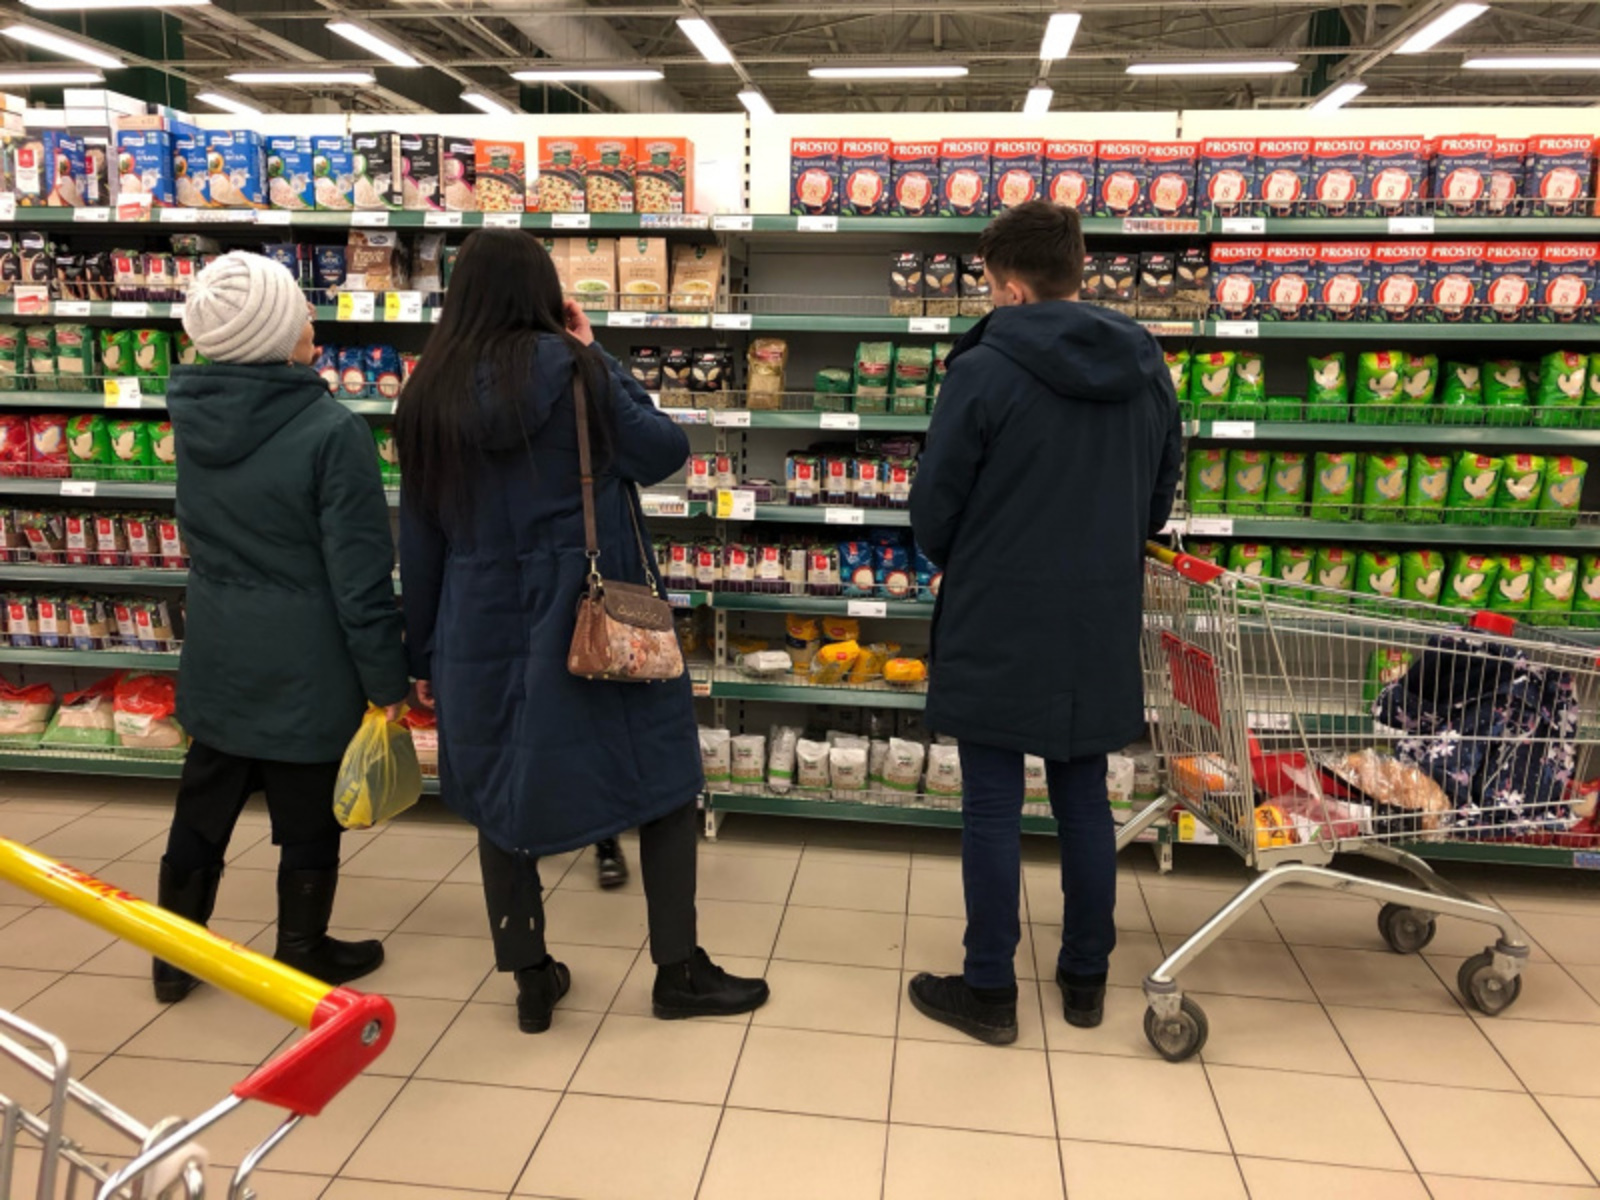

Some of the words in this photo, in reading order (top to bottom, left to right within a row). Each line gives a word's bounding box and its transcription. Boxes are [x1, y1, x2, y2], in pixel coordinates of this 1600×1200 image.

[793, 141, 838, 153] PROSTO
[843, 141, 888, 153] PROSTO
[893, 144, 938, 155] PROSTO
[943, 141, 989, 153] PROSTO
[995, 141, 1041, 153] PROSTO
[1047, 143, 1093, 154] PROSTO
[1100, 143, 1146, 155] PROSTO
[1205, 141, 1254, 152] PROSTO
[1260, 141, 1309, 152] PROSTO
[1315, 140, 1365, 151] PROSTO
[1369, 139, 1420, 151] PROSTO
[1441, 139, 1493, 150] PROSTO
[1539, 139, 1591, 149] PROSTO
[1148, 145, 1194, 157] PROSTO
[1214, 246, 1262, 257] PROSTO
[1267, 246, 1316, 257] PROSTO
[1321, 246, 1370, 257] PROSTO
[1376, 246, 1426, 257] PROSTO
[1432, 246, 1483, 257] PROSTO
[1487, 246, 1539, 257] PROSTO
[1545, 246, 1596, 258] PROSTO
